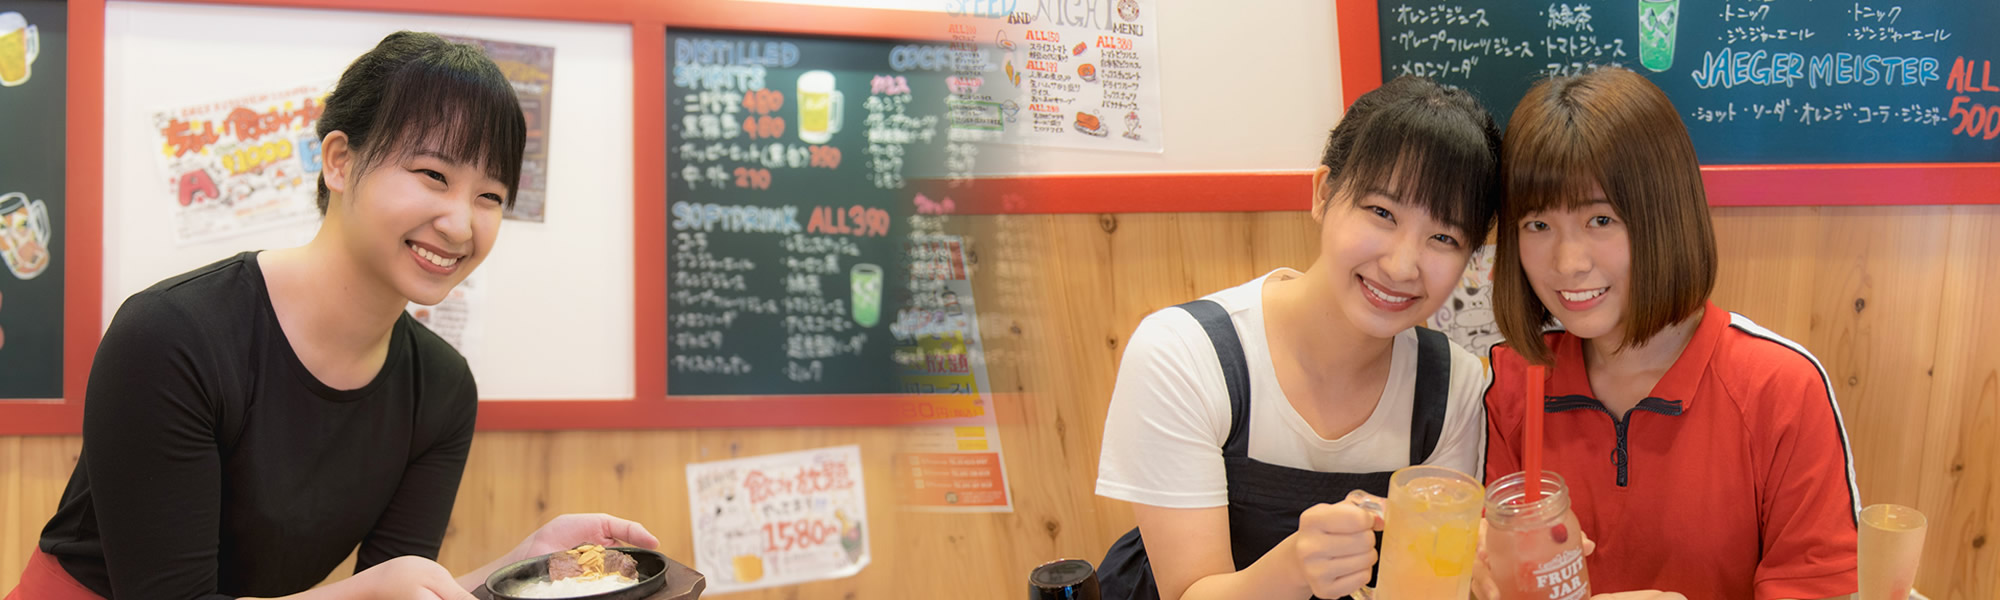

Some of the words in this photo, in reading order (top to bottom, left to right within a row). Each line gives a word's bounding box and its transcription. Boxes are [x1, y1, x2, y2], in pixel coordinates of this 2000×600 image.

[1007, 11, 1032, 25] AND
[1398, 4, 1490, 28] オレンジジュース
[1548, 3, 1594, 32] 緑茶
[1725, 4, 1770, 21] トニック
[1855, 2, 1902, 25] トニック
[1112, 22, 1144, 37] MENU
[1726, 25, 1816, 44] ジンジャーエール
[1854, 26, 1952, 43] ジンジャーエール
[674, 38, 798, 68] DISTILLED
[1400, 29, 1535, 58] グレープフルーツジュース
[1546, 35, 1627, 58] トマトジュース
[1946, 56, 2000, 94] ALL
[1753, 98, 1790, 122] ソーダ
[1800, 102, 1852, 125] オレンジ
[1858, 105, 1891, 124] コーラ
[1949, 95, 2000, 140] 500
[178, 169, 219, 206] A
[743, 461, 855, 504] 飲み放題
[1536, 555, 1583, 588] FRUIT
[1549, 575, 1581, 599] JAR
